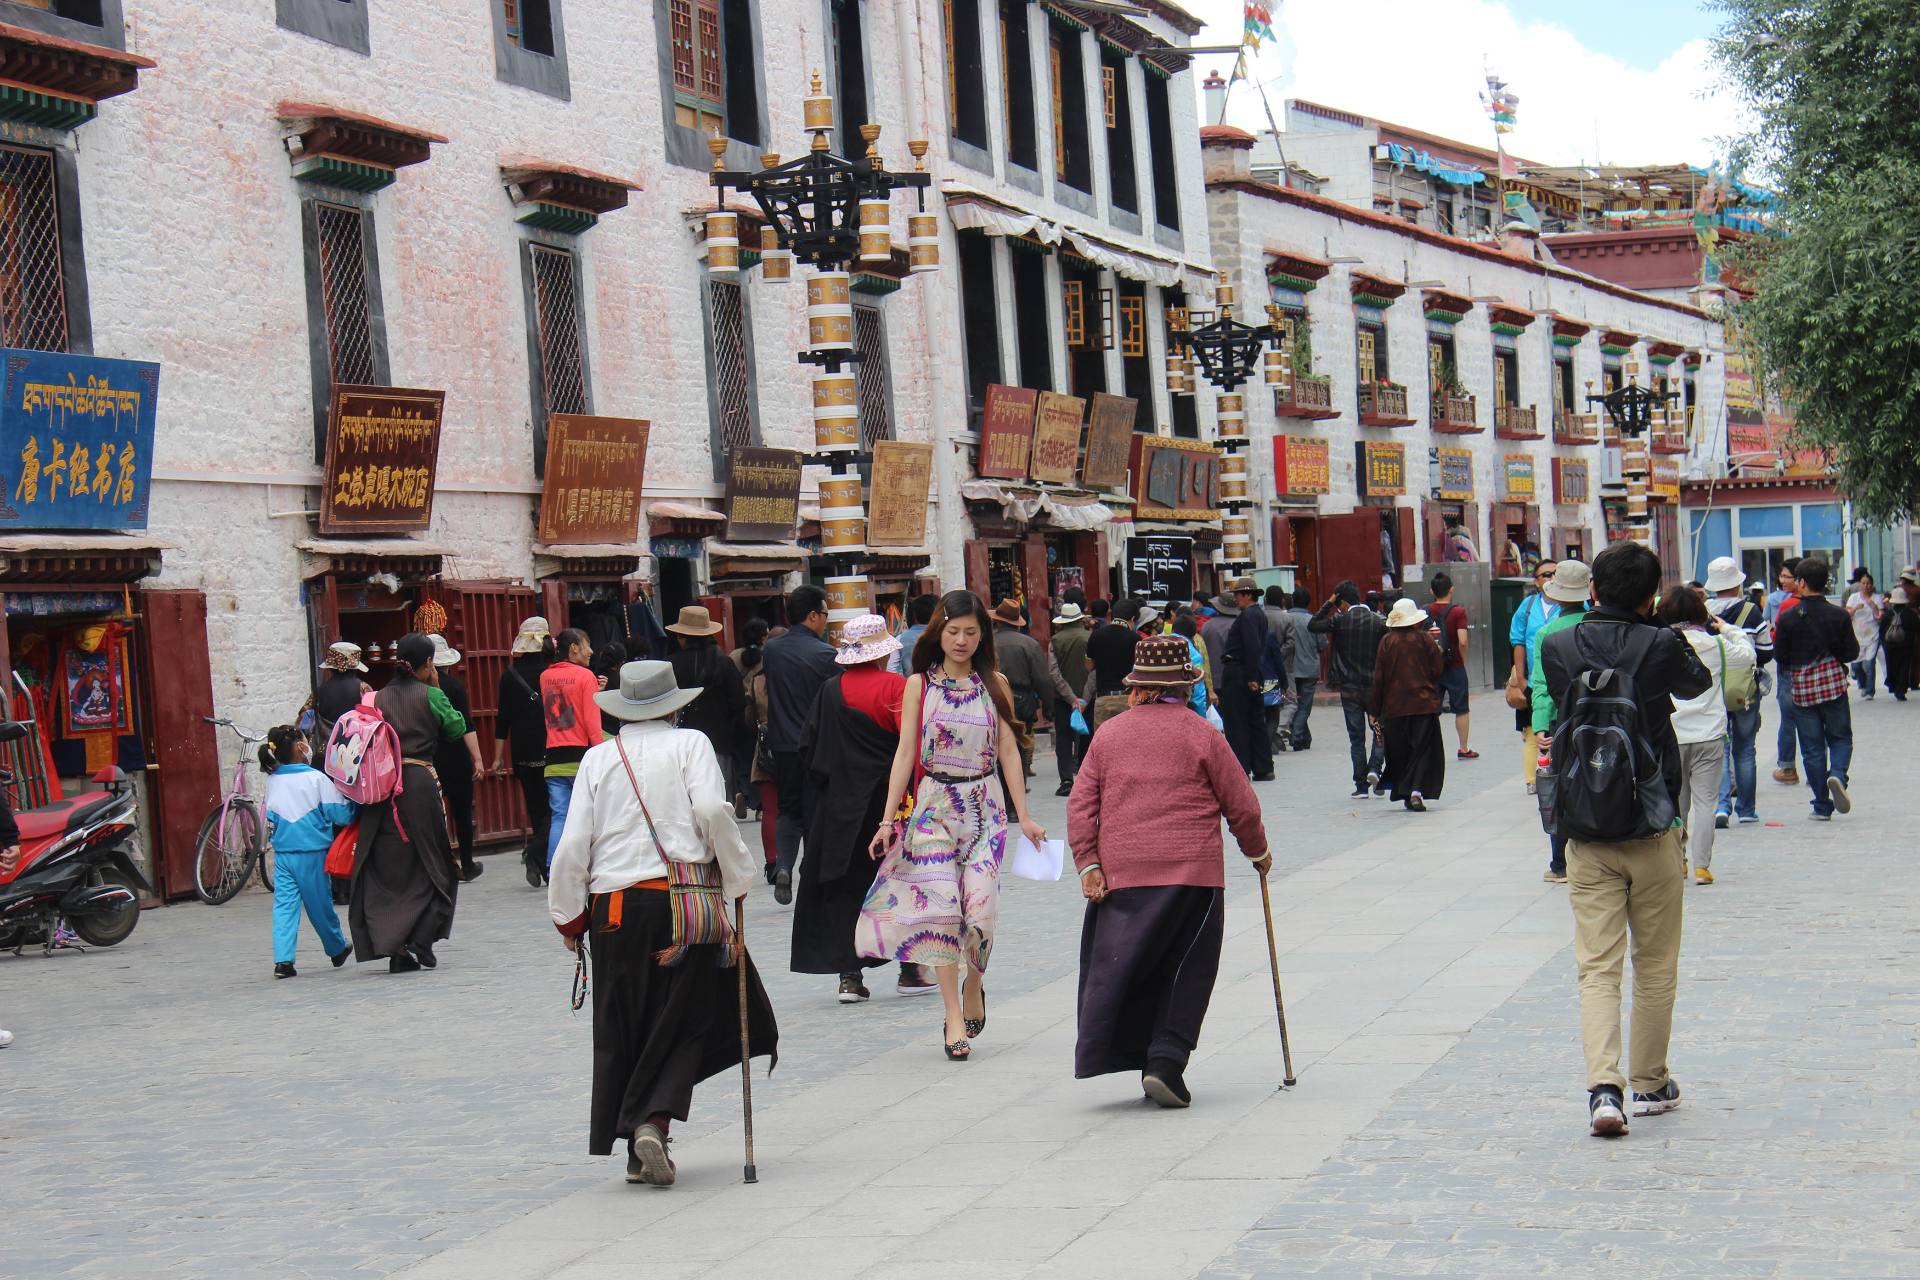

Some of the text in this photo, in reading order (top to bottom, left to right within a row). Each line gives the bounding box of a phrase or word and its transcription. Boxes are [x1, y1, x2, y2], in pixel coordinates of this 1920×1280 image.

[15, 435, 136, 506] 唐卡经书店
